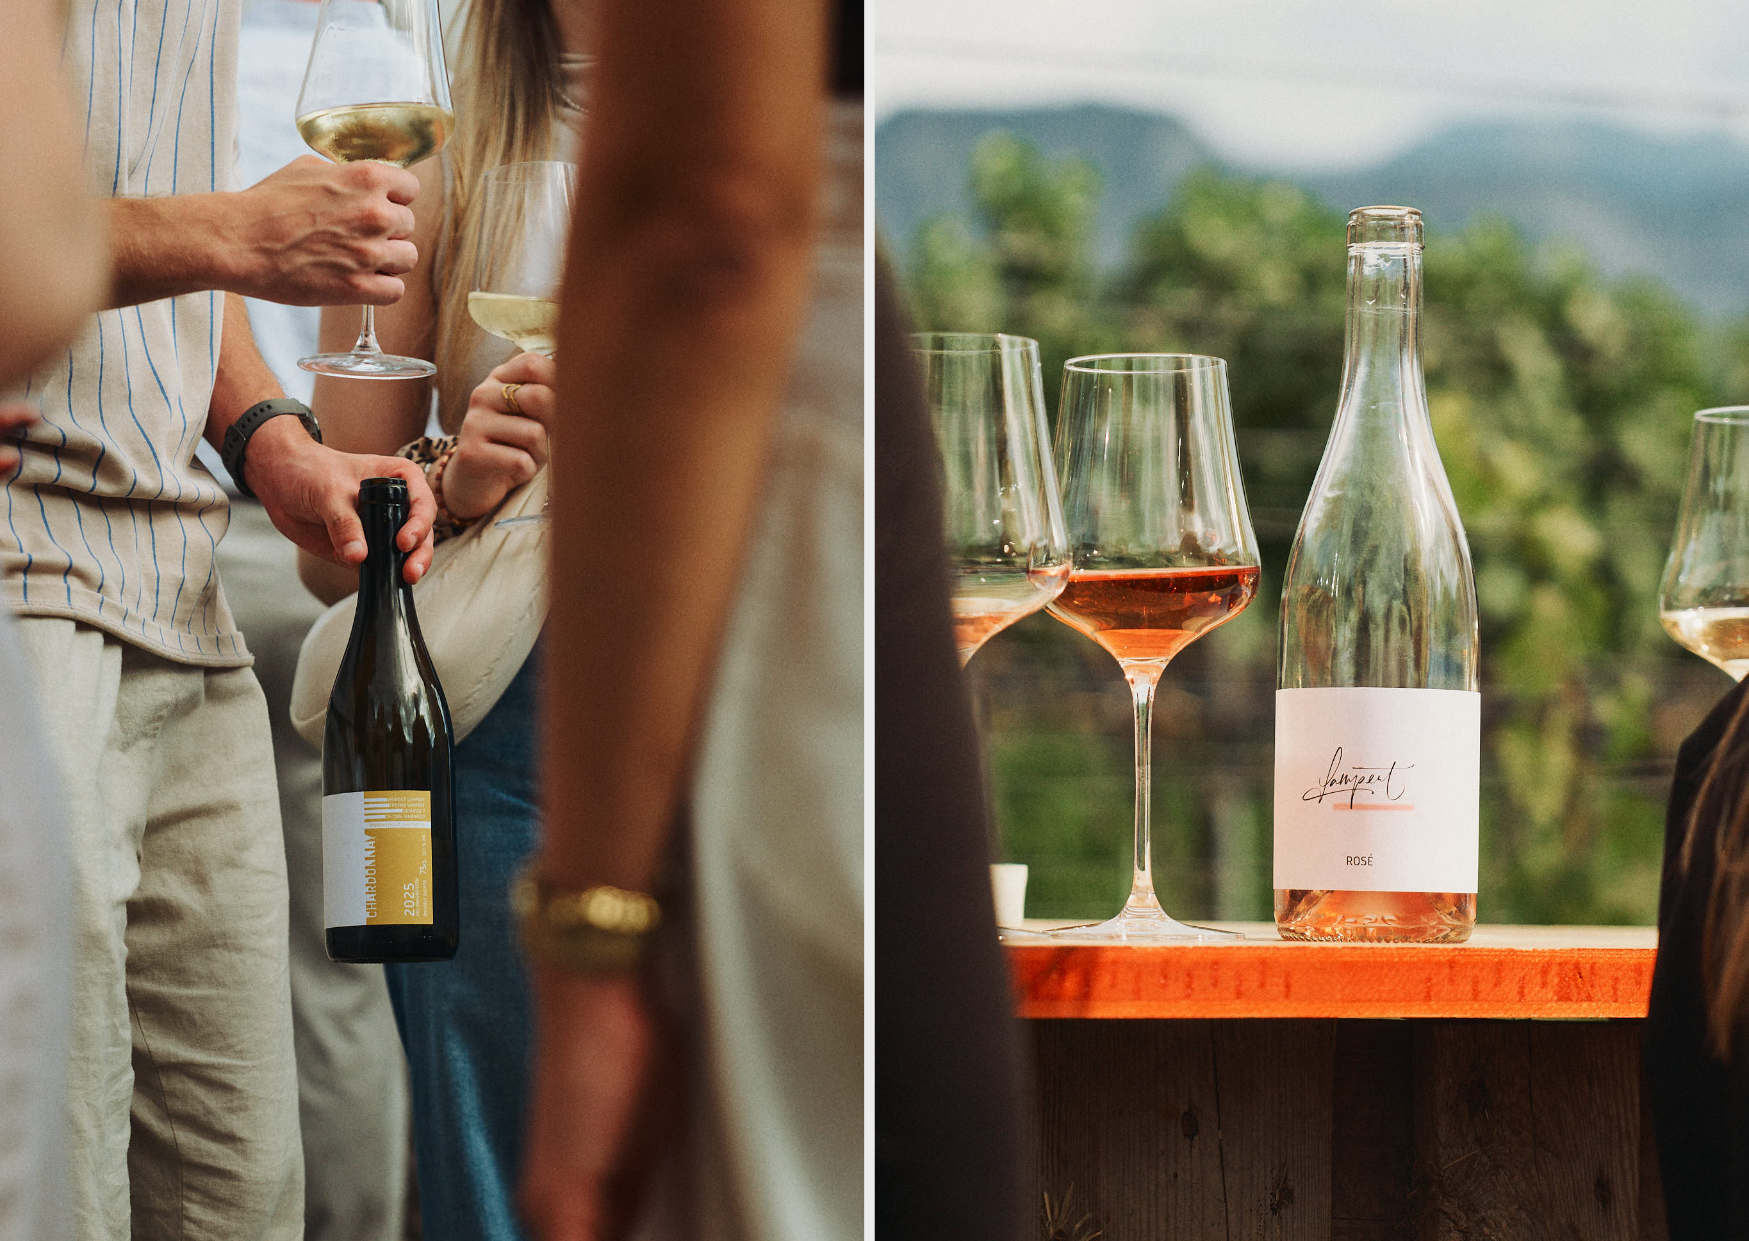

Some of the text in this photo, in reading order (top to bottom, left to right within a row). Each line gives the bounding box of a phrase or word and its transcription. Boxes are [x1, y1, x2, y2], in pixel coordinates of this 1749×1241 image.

[364, 830, 377, 918] CHARDONNAY
[1346, 853, 1374, 866] ROSÉ
[403, 882, 415, 917] 2025
